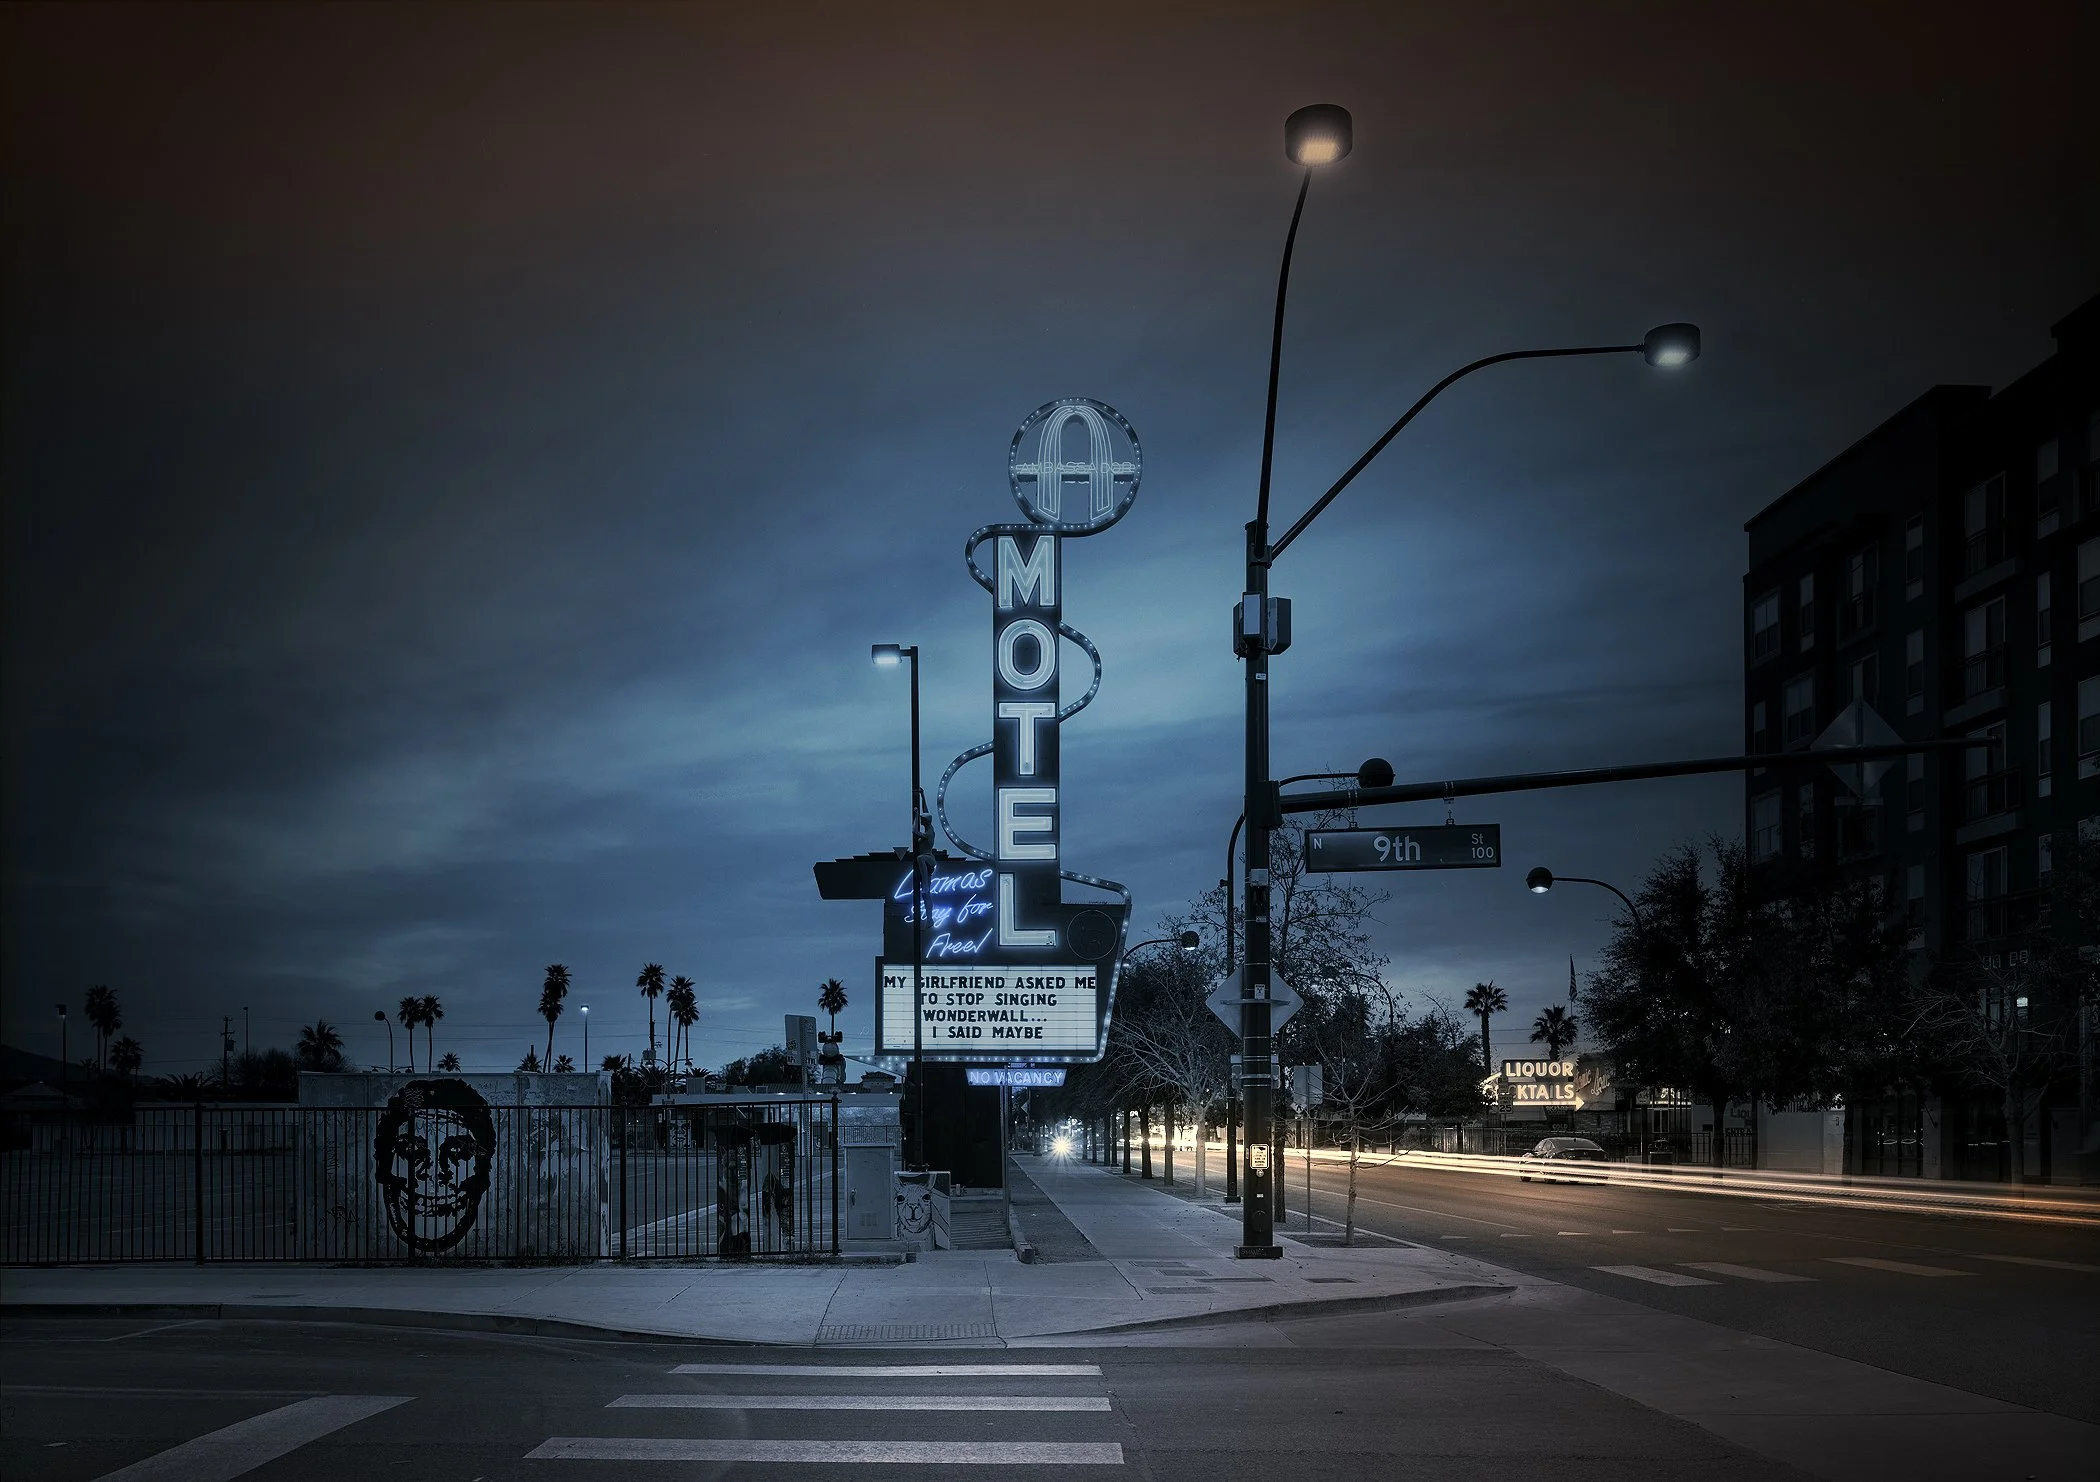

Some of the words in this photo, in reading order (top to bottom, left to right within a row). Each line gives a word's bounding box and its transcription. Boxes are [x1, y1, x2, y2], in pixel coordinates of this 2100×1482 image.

[1018, 461, 1136, 474] AMBASSADOR
[997, 534, 1058, 947] MOTEL
[1313, 838, 1322, 850] N
[1373, 835, 1421, 862] 9th
[1471, 833, 1484, 845] St
[1471, 846, 1494, 859] 100
[894, 866, 993, 899] Lamas
[957, 894, 994, 923] for
[926, 928, 993, 958] Free!
[884, 976, 907, 989] MY
[1014, 976, 1066, 989] ASKED
[1075, 976, 1096, 989] ME
[921, 993, 938, 1006] TO
[946, 993, 984, 1006] STOP
[994, 993, 1057, 1006] SINGING
[923, 1009, 1047, 1022] WONDERWALL...
[932, 1026, 937, 1038] I
[947, 1026, 982, 1039] SAID
[992, 1026, 1043, 1039] MAYBE
[1505, 1062, 1574, 1077] LIQUOR
[969, 1071, 990, 1084] NO
[994, 1070, 1063, 1084] VACANCY
[1500, 1104, 1512, 1112] 25
